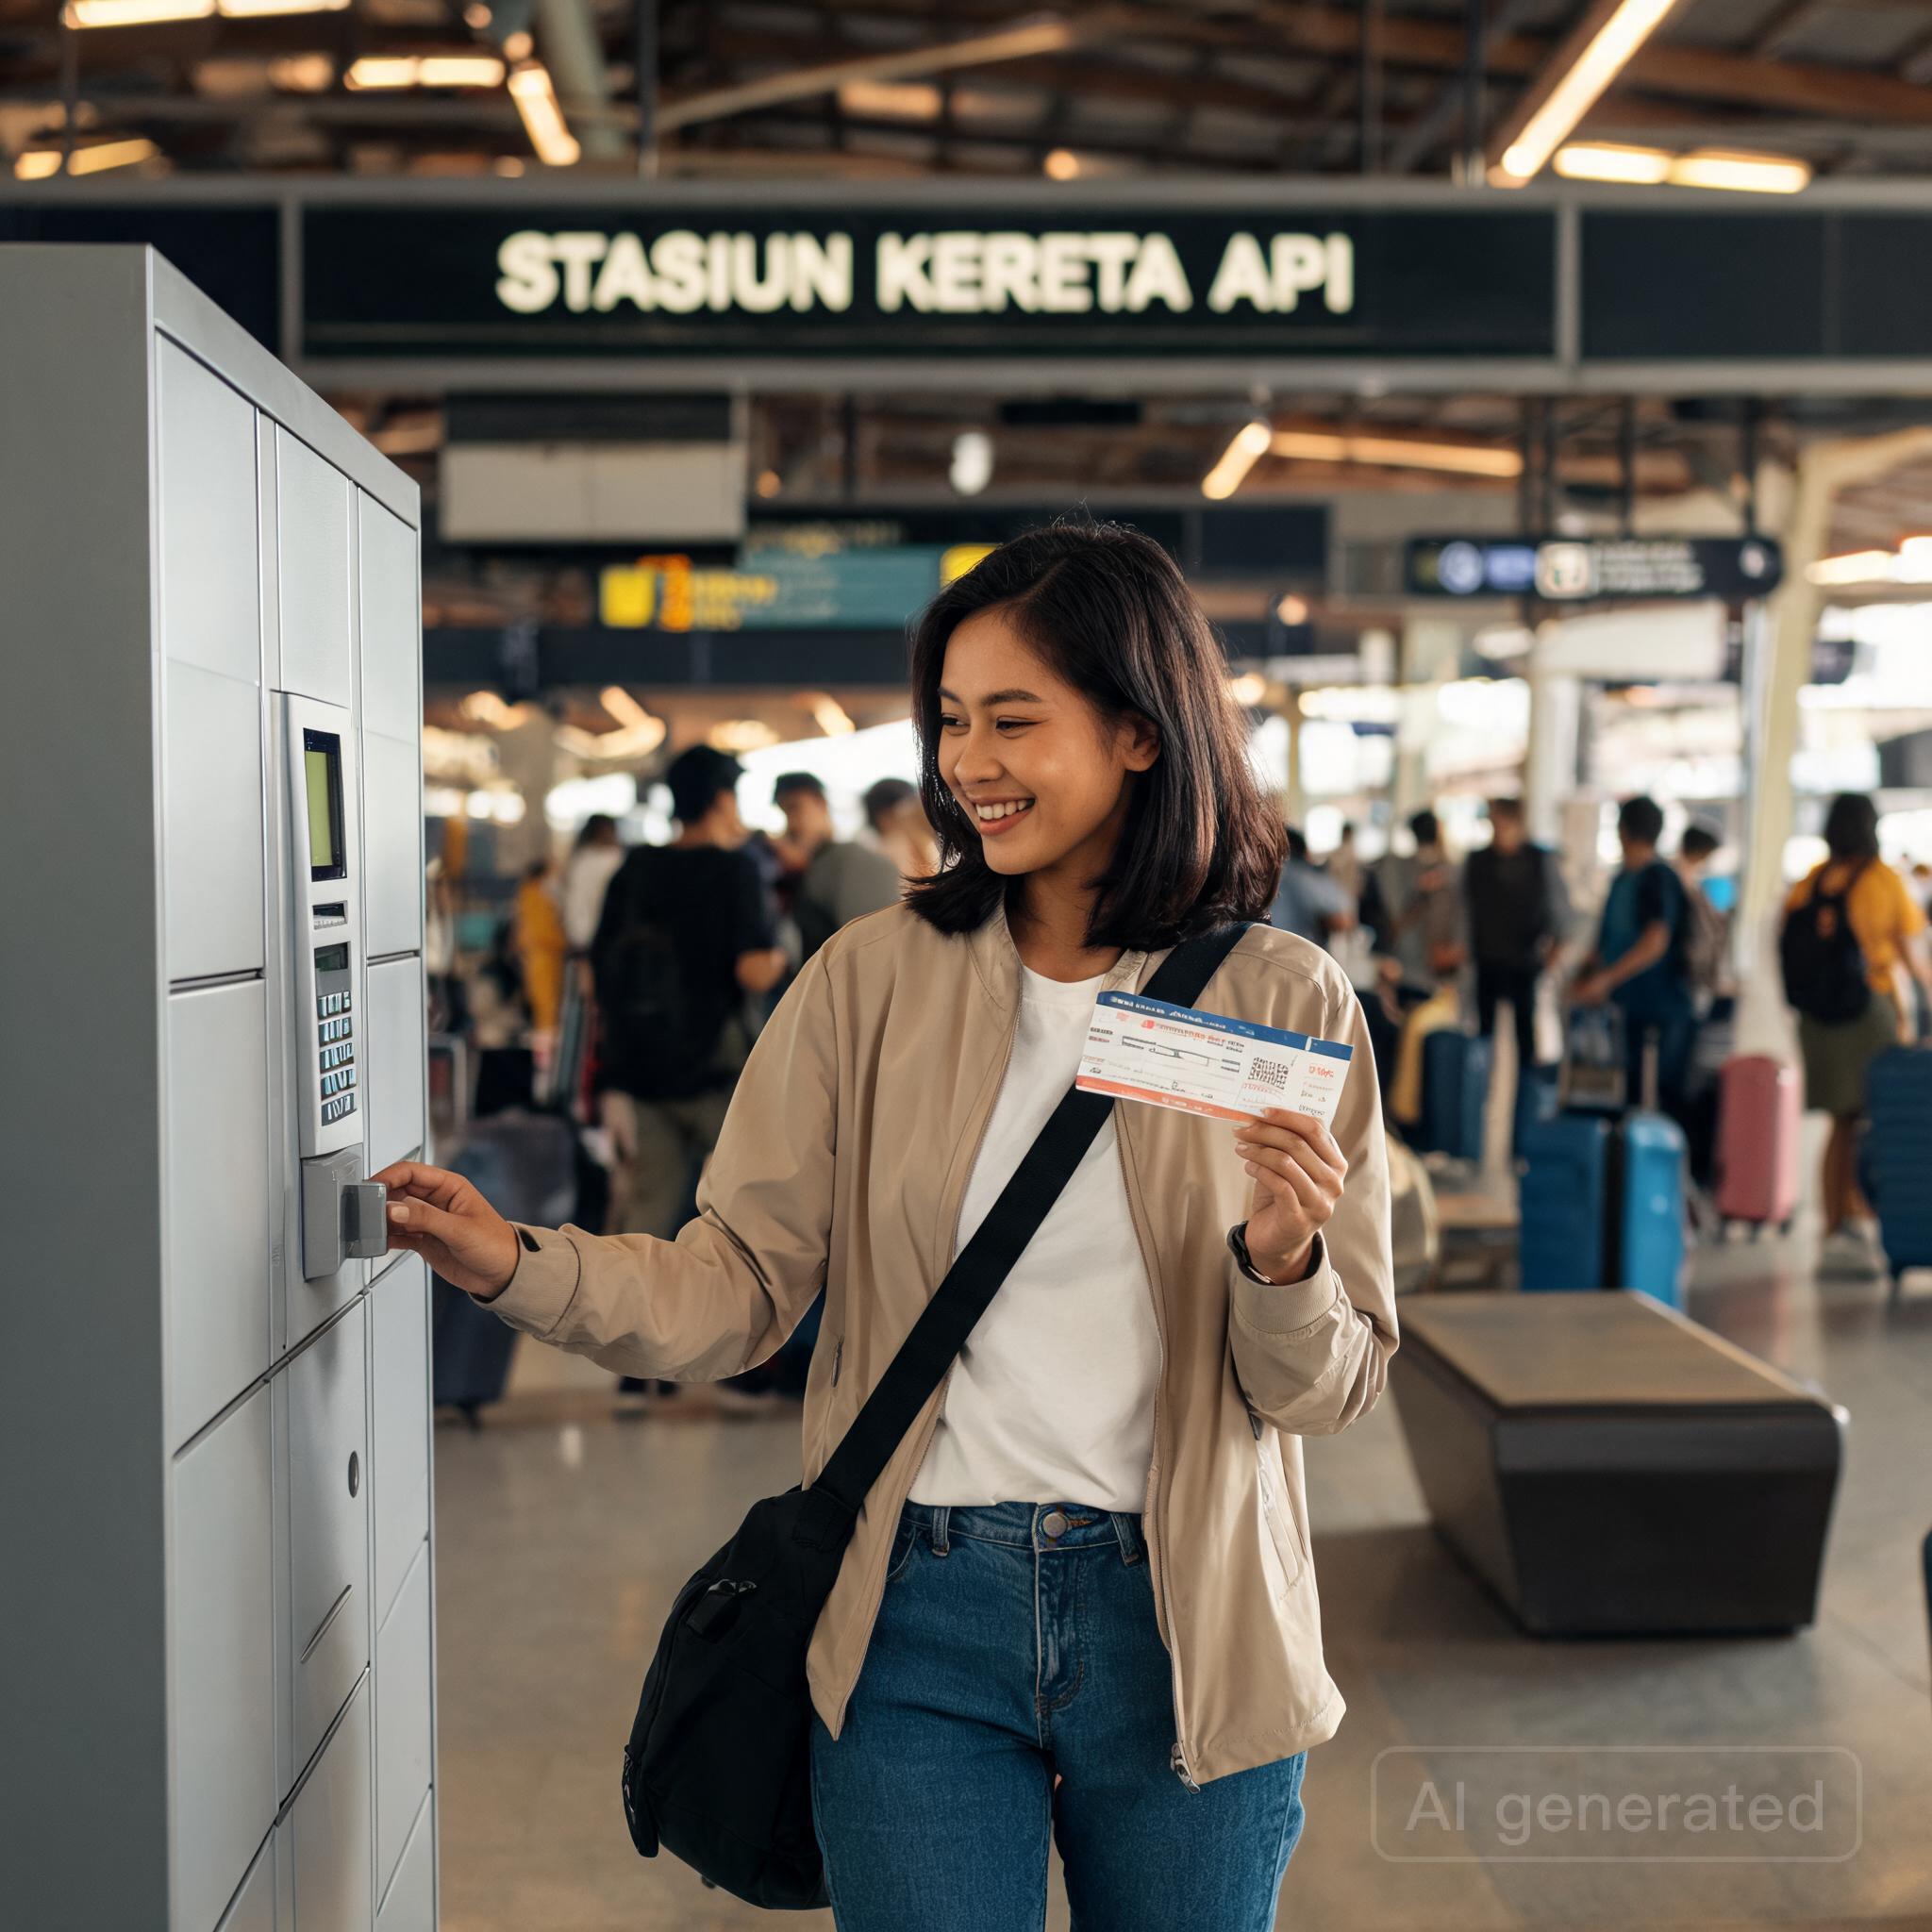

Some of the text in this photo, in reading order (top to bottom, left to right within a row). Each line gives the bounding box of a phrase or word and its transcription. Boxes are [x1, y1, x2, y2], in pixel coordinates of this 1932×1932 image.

[495, 231, 1355, 313] STASIUN KERETA API
